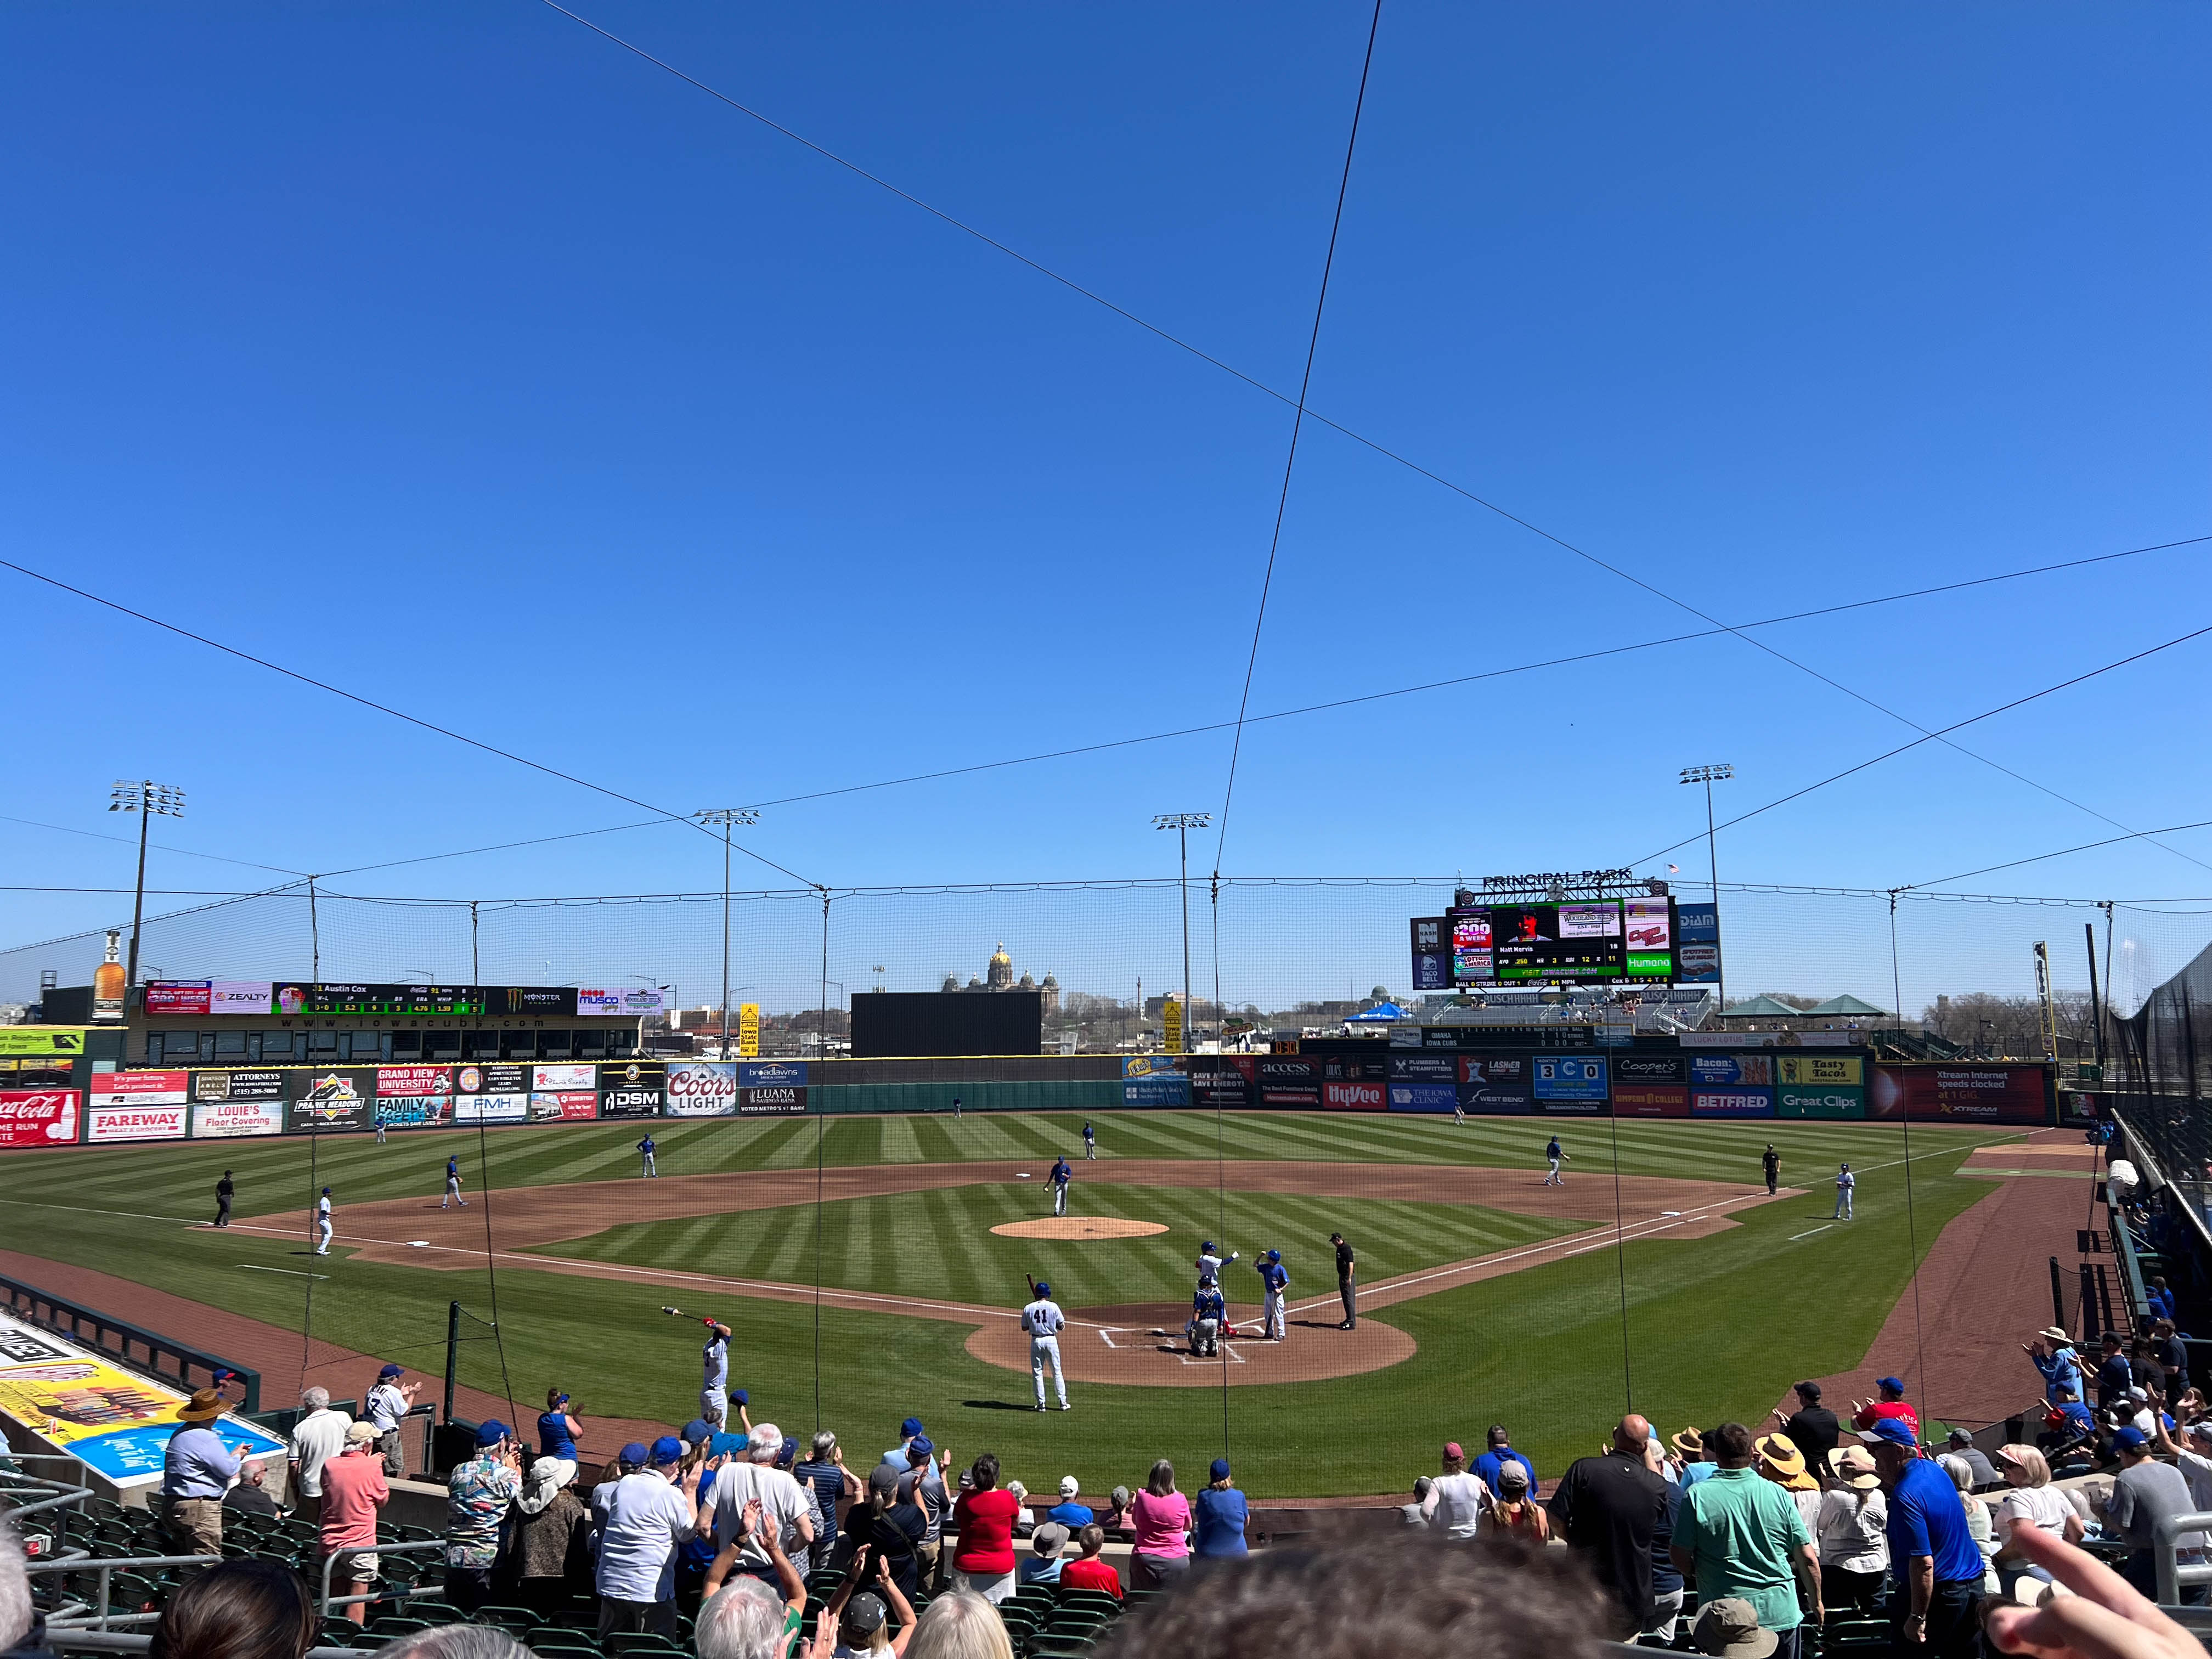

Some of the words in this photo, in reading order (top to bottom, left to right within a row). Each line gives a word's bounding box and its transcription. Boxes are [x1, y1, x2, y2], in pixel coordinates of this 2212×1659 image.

[1483, 871, 1576, 887] PRINCIPAL
[1582, 868, 1632, 883] PARK
[1454, 923, 1491, 935] $200
[1628, 958, 1669, 967] Humana
[524, 992, 561, 1001] MONSTER
[1621, 1059, 1677, 1074] Cooper's
[1696, 1058, 1732, 1067] Bacon:
[1812, 1060, 1846, 1070] Tasty
[749, 1066, 798, 1076] broadlawns
[1262, 1063, 1310, 1073] access
[1326, 1064, 1342, 1076] LOLA'S
[1544, 1065, 1553, 1077] 3
[1562, 1062, 1576, 1075] C
[1587, 1065, 1596, 1077] 0
[1812, 1069, 1846, 1077] Tacos
[379, 1069, 410, 1079] GRAND
[414, 1069, 435, 1078] VIEW
[1937, 1071, 1970, 1079] Xtream
[1972, 1071, 2008, 1080] Internet
[379, 1079, 432, 1089] UNIVERSITY
[567, 1078, 589, 1086] Supply
[668, 1071, 736, 1096] Coors
[1937, 1080, 1969, 1089] speeds
[1971, 1080, 2005, 1088] clocked
[757, 1088, 795, 1098] LUANA
[1938, 1091, 1950, 1099] at
[473, 1098, 511, 1109] FMH
[617, 1092, 659, 1105] DSM
[679, 1097, 725, 1109] LIGHT
[1655, 1096, 1684, 1104] COLLEGE
[1697, 1096, 1768, 1108] BETFRED
[1783, 1094, 1822, 1107] Great
[1824, 1096, 1857, 1110] Clips
[328, 1100, 362, 1109] MEADOWS
[377, 1097, 425, 1112] FAMILY
[217, 1105, 259, 1116] LOUIE'S
[96, 1114, 179, 1127] FAREWAY
[206, 1119, 230, 1127] Floor
[1034, 1309, 1047, 1323] 41
